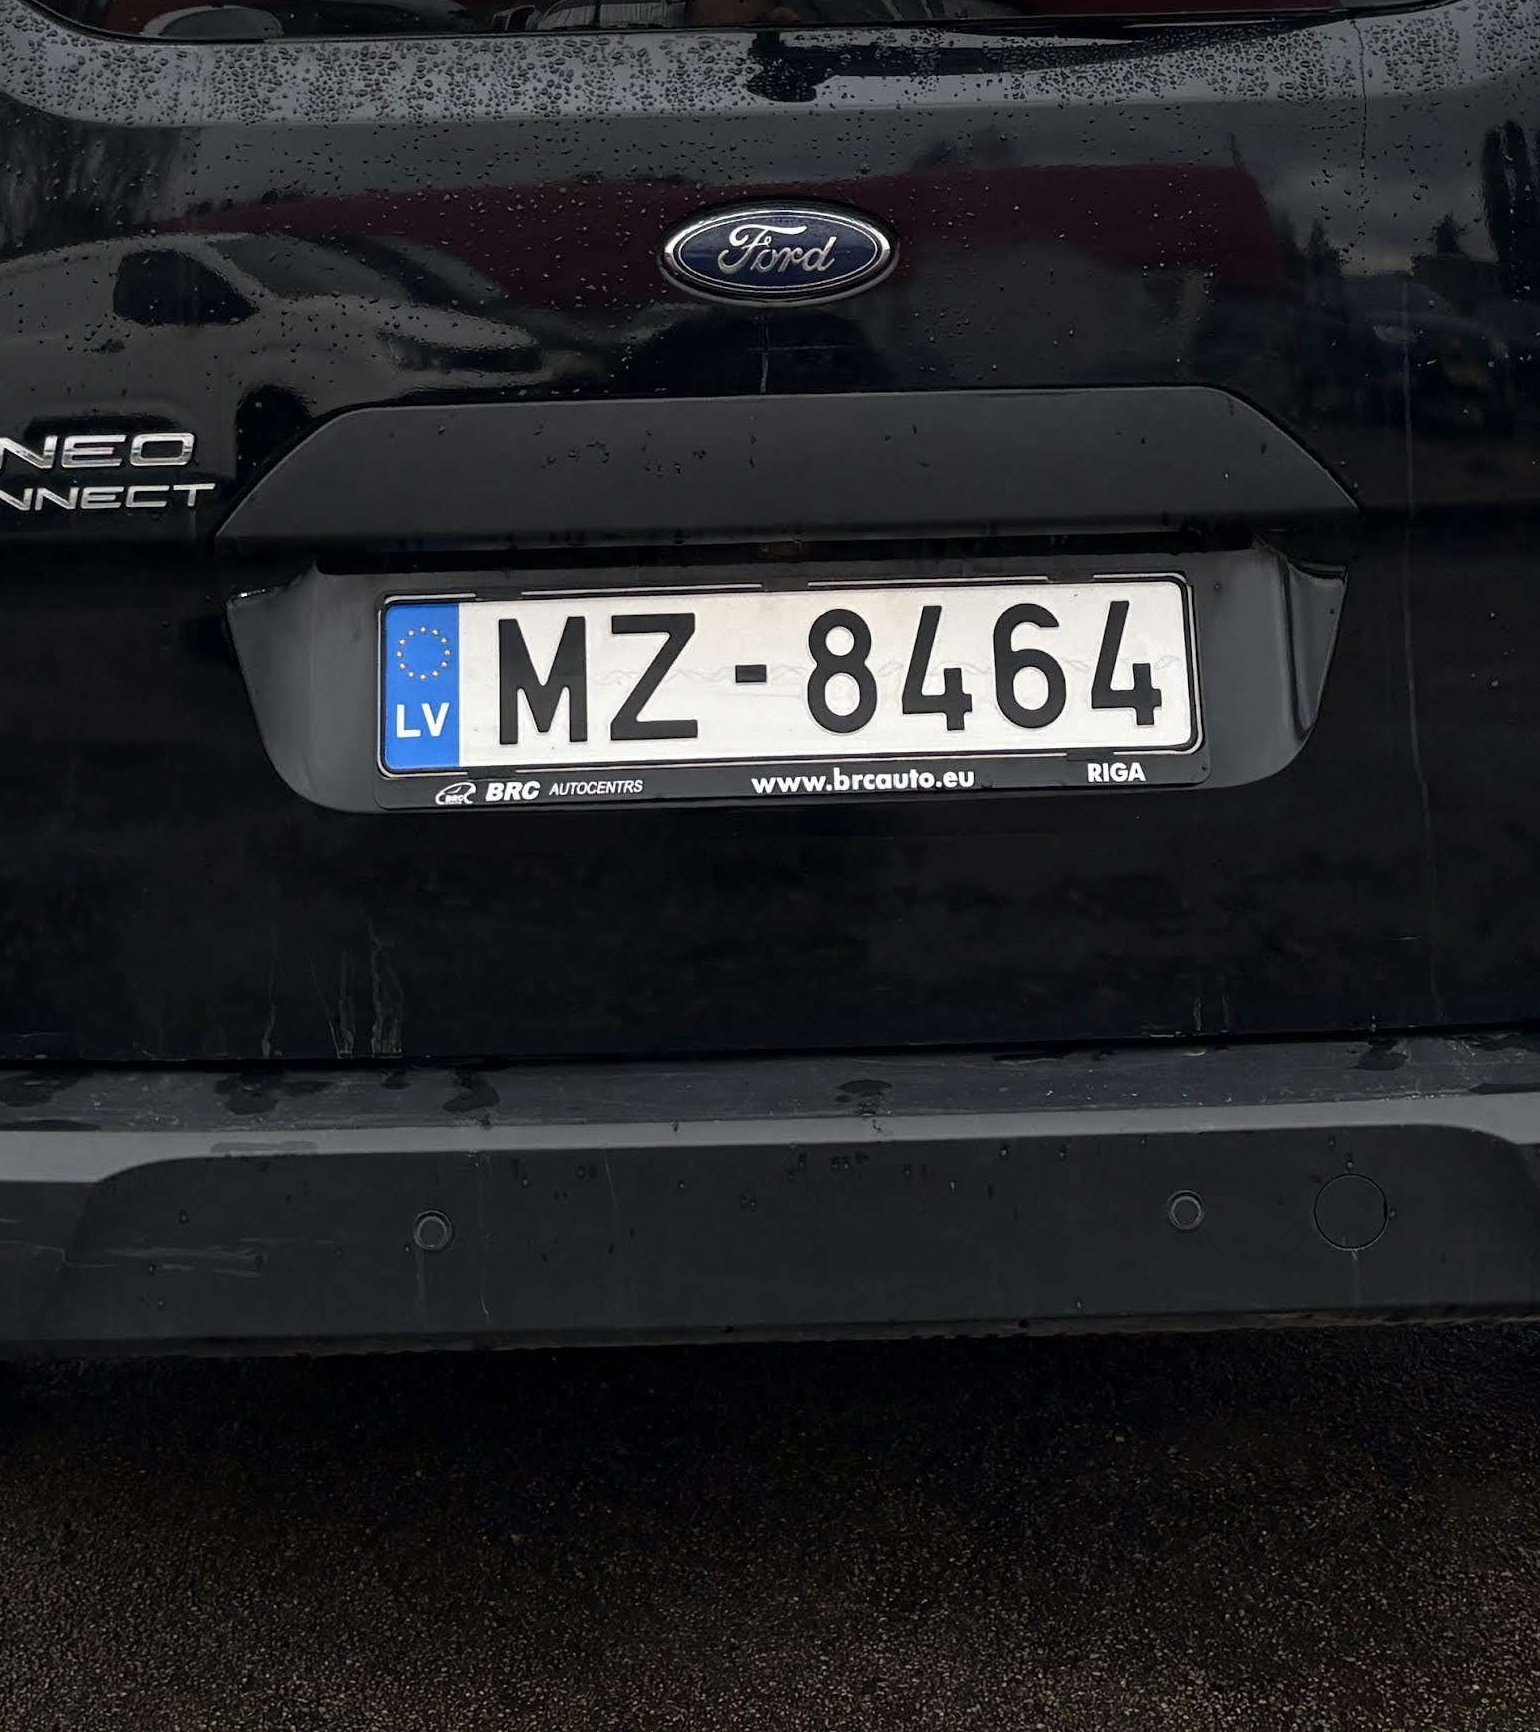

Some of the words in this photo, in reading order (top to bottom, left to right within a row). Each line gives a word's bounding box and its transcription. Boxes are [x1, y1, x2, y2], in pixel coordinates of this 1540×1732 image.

[717, 224, 837, 274] Ford
[395, 701, 451, 740] LV
[751, 766, 976, 795] www.brcauto.eu
[1086, 761, 1146, 784] RIGA
[485, 780, 541, 802] BRC
[549, 779, 644, 796] AUTOCENTRS
